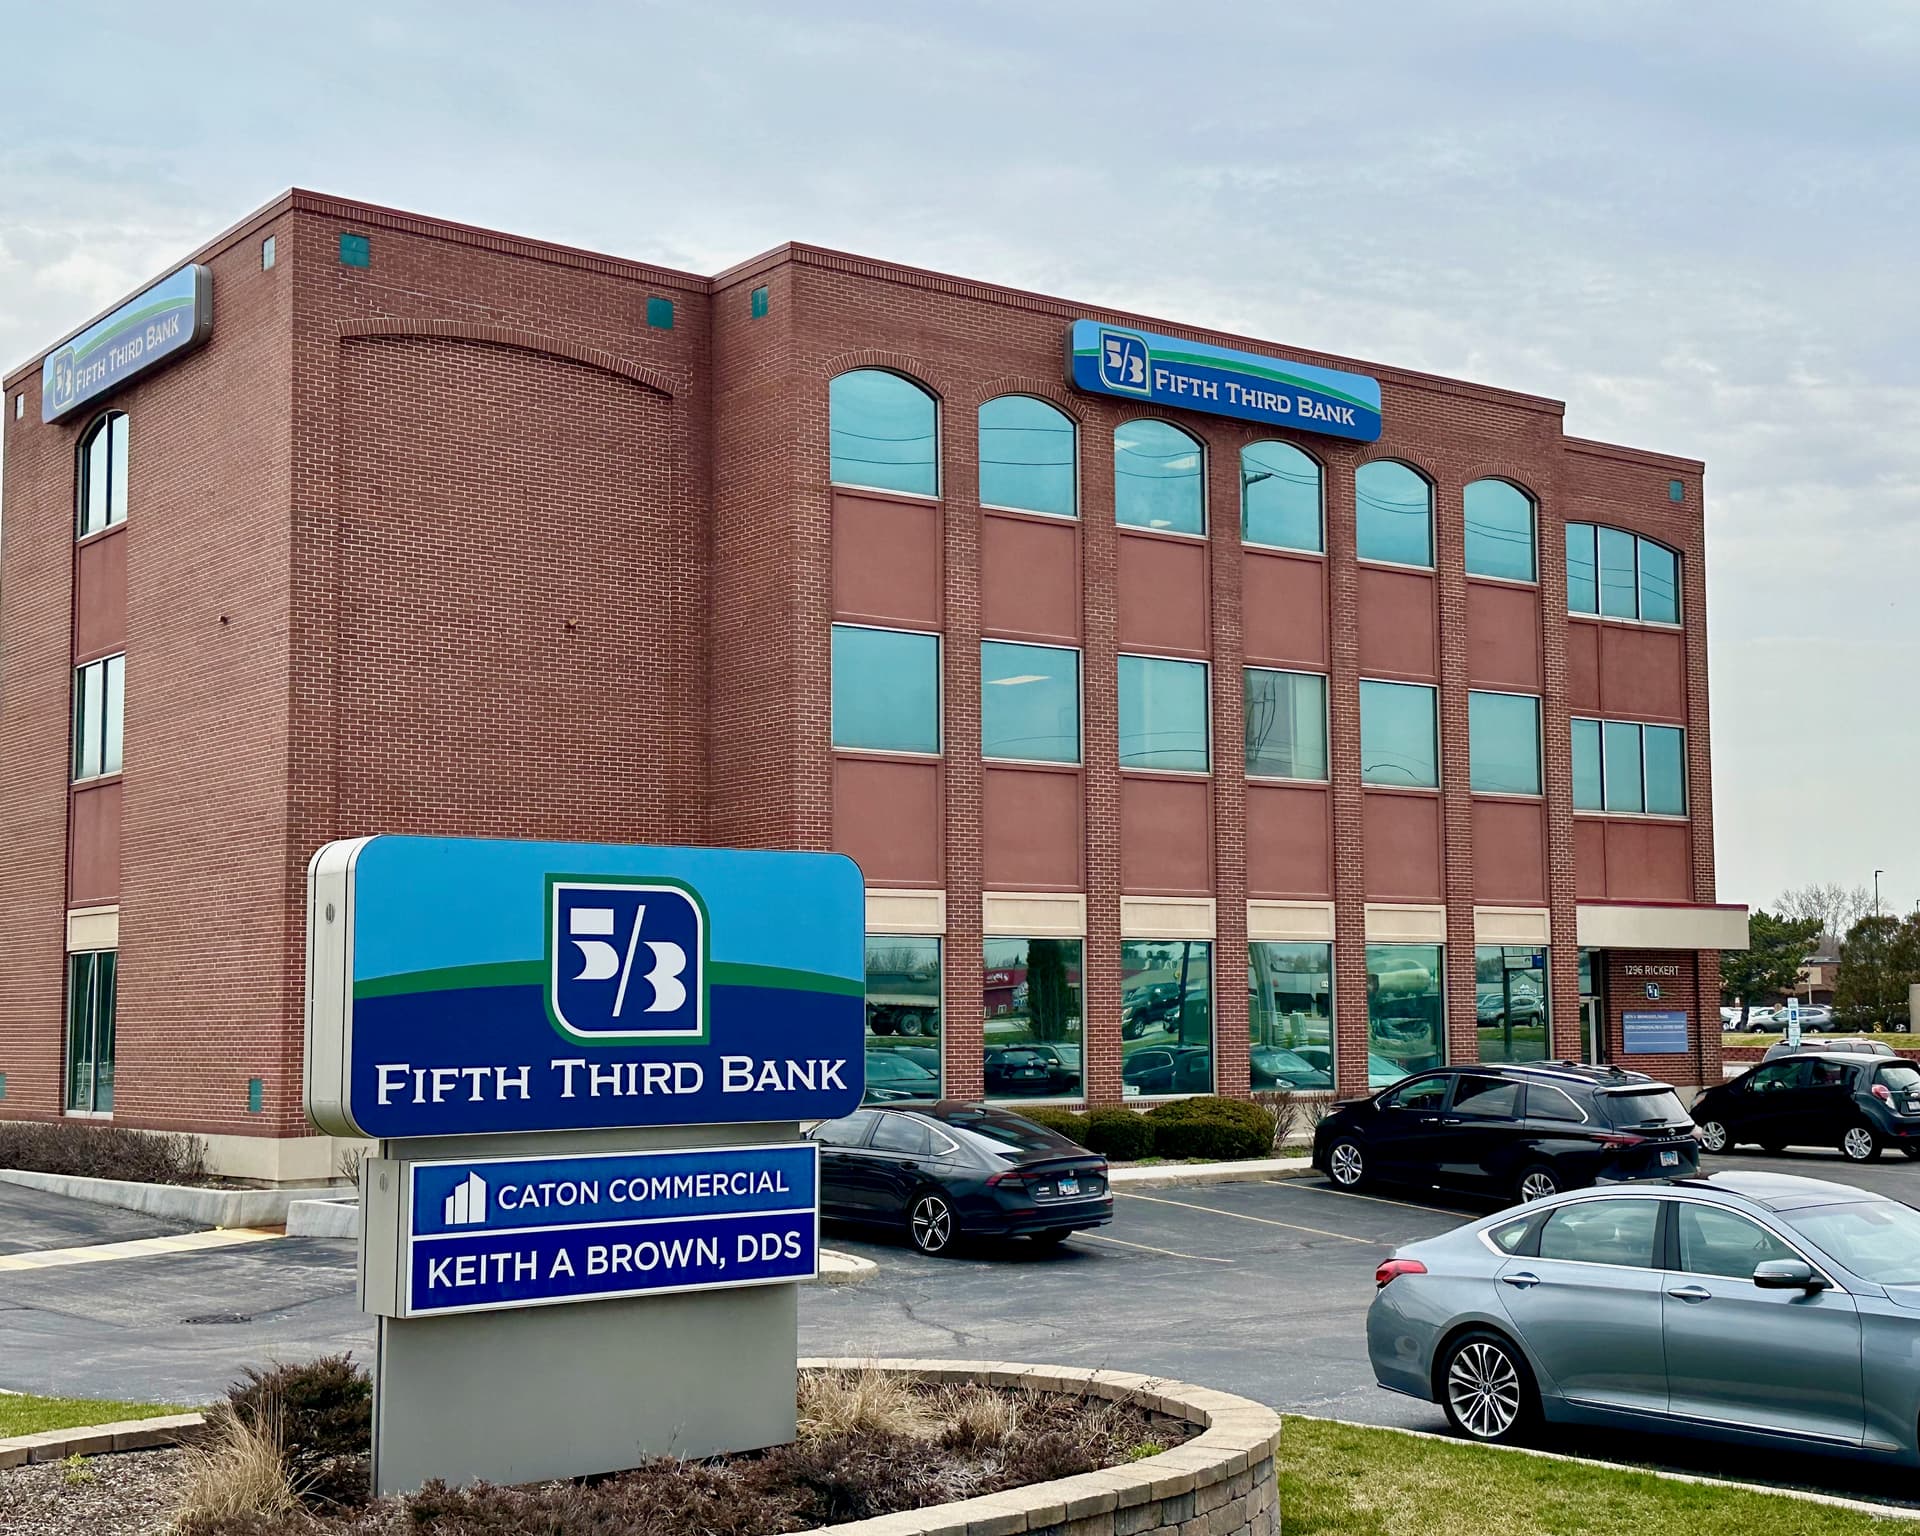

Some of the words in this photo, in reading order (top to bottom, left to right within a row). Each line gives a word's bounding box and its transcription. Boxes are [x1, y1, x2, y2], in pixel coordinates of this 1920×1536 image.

[76, 357, 106, 393] FIFTH
[109, 337, 144, 372] THIRD
[146, 313, 181, 351] BANK
[1154, 368, 1218, 401] FIFTH
[1224, 382, 1292, 414] THIRD
[1296, 395, 1356, 427] BANK
[1624, 965, 1644, 976] 1296
[1644, 965, 1680, 976] RICKERT
[375, 1063, 531, 1105] FIFTH
[550, 1058, 704, 1098] THIRD
[720, 1055, 848, 1093] BANK
[498, 1181, 600, 1210] CATON
[609, 1170, 790, 1203] COMMERCIAL
[428, 1250, 537, 1289] KEITH
[549, 1248, 575, 1279] A
[587, 1236, 726, 1275] BROWN,
[737, 1231, 802, 1263] DDS
